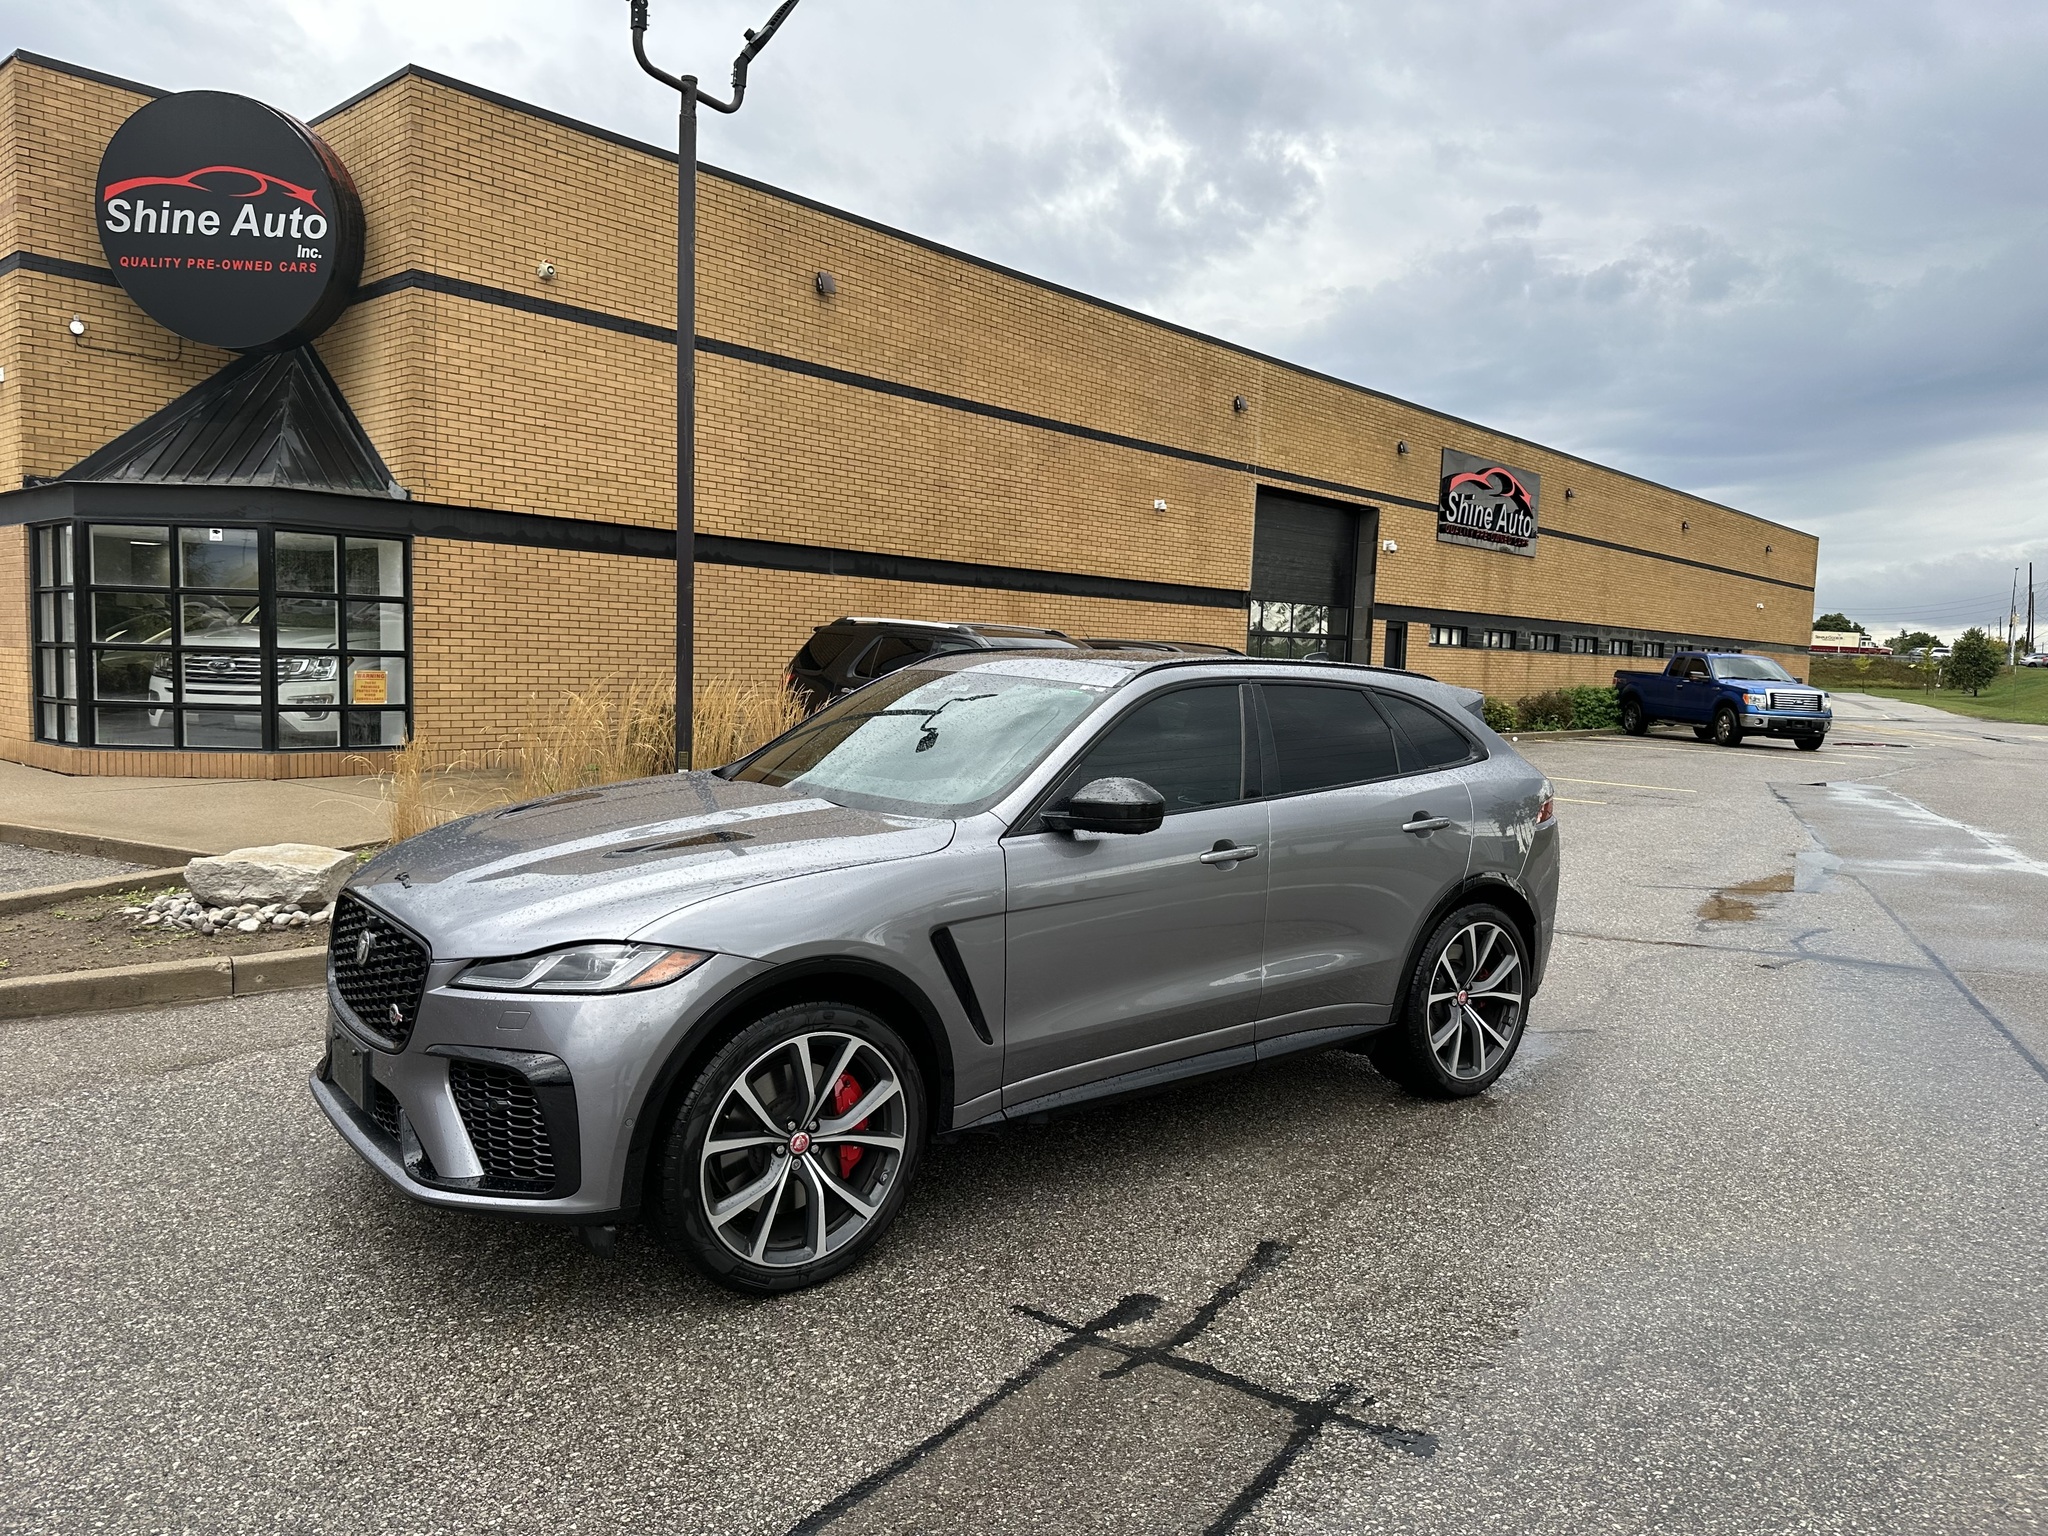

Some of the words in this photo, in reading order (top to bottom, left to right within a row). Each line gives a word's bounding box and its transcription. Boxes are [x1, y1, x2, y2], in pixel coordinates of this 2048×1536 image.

[105, 198, 220, 236] Shine
[230, 203, 328, 240] Auto
[119, 256, 182, 269] QUALITY
[187, 258, 273, 272] PRE-OWNED
[279, 261, 317, 273] CARS
[296, 244, 322, 259] Inc.
[1446, 491, 1493, 529] Shine
[1495, 503, 1532, 537] Auto
